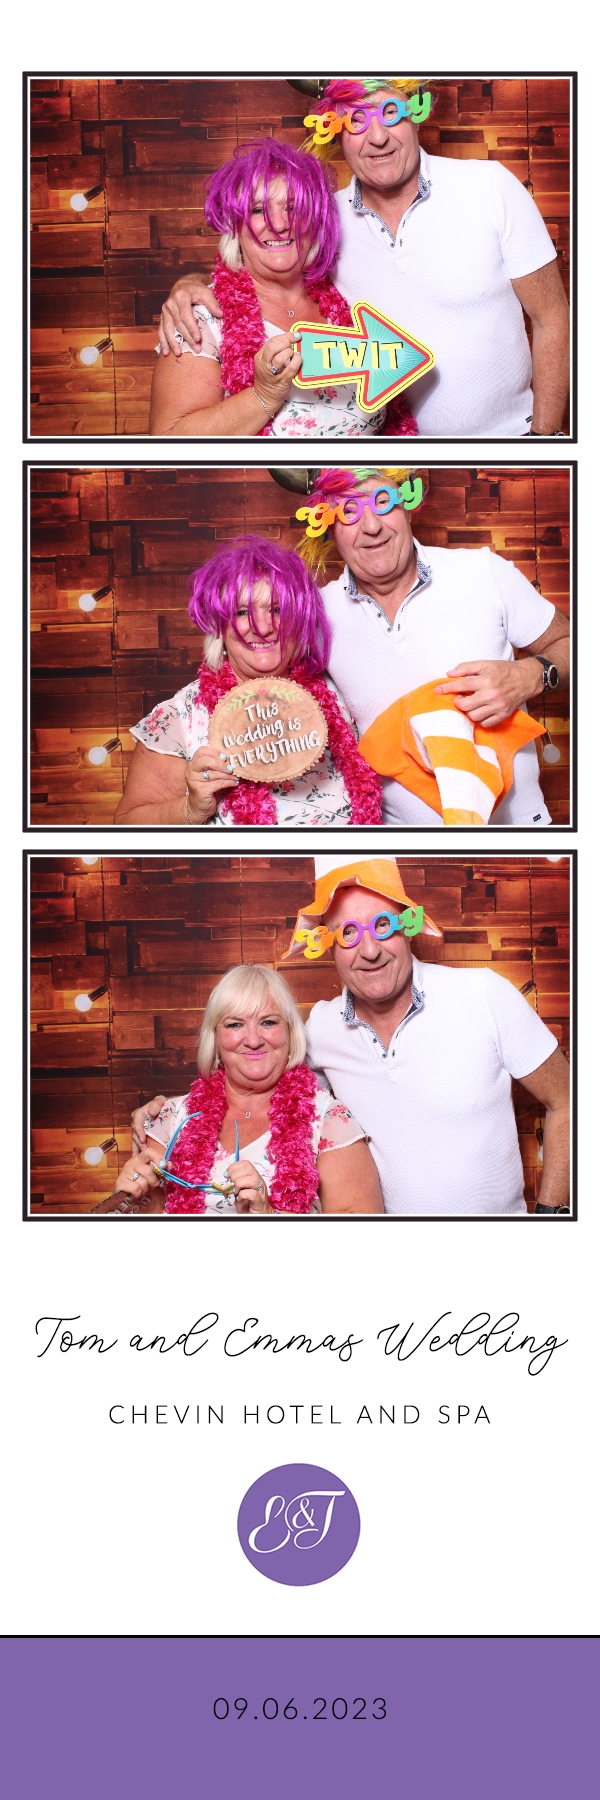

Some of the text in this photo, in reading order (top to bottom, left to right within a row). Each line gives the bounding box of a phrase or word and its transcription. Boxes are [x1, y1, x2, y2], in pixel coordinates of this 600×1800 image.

[313, 340, 404, 370] TWIT
[244, 702, 279, 721] This
[288, 717, 301, 731] is
[228, 730, 321, 767] EVERYTHING
